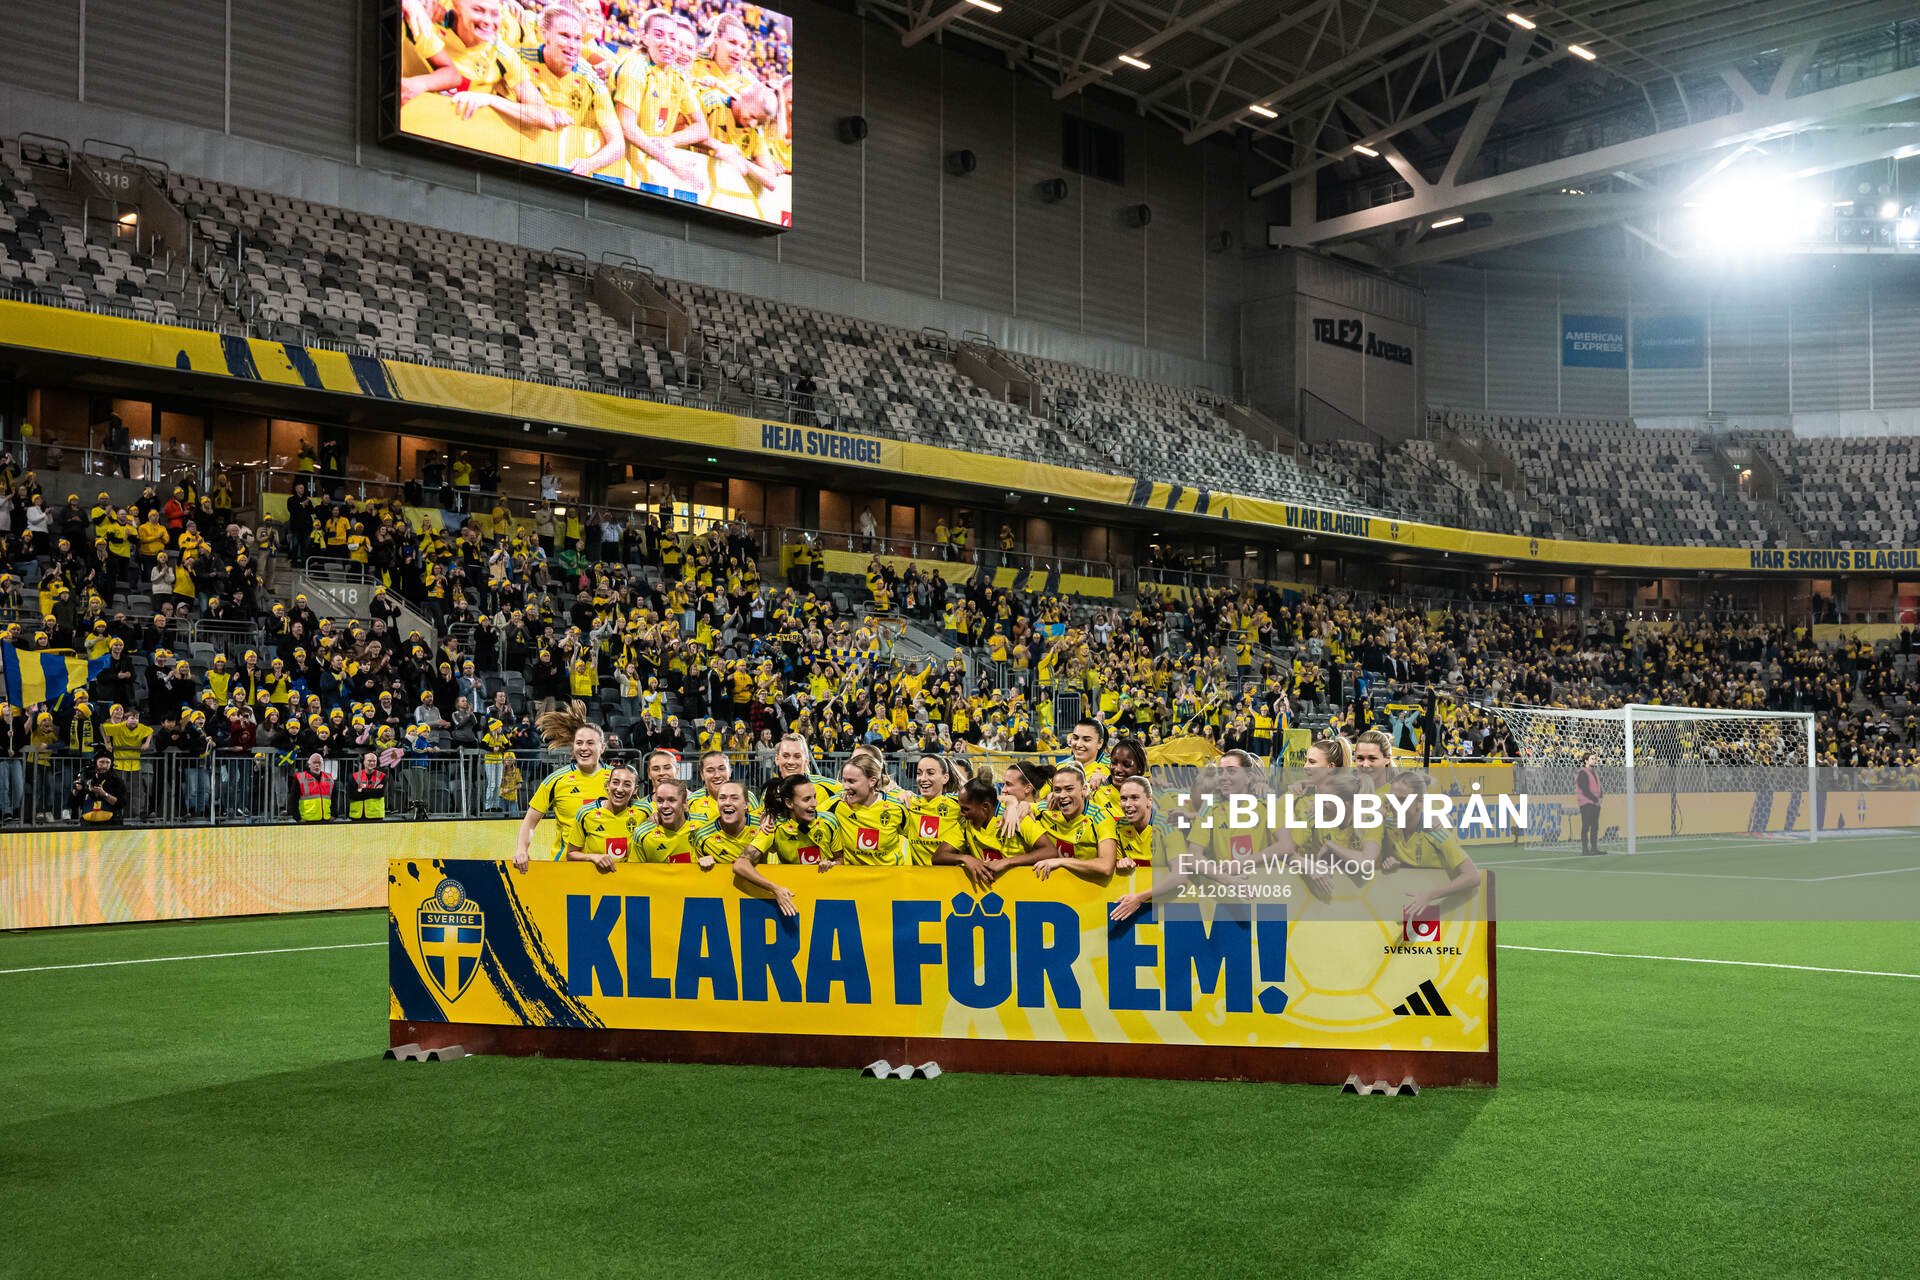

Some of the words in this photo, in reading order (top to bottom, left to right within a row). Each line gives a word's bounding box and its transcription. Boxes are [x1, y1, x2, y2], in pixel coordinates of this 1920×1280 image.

[1313, 319, 1364, 353] TELE2
[1366, 331, 1412, 365] Arena
[1565, 331, 1623, 342] AMERICAN
[1573, 341, 1624, 352] EXPRESS
[761, 423, 804, 453] HEJA
[806, 431, 881, 464] SVERIGE!
[1285, 505, 1299, 528] VI
[1788, 550, 1850, 569] SKRIVS
[427, 914, 475, 924] SVERIGE
[566, 894, 872, 1004] KLARA
[892, 891, 1082, 1009] FÖR
[1107, 902, 1289, 1014] EM!
[1384, 945, 1433, 955] SVENSKA
[1436, 946, 1462, 955] SPEL
